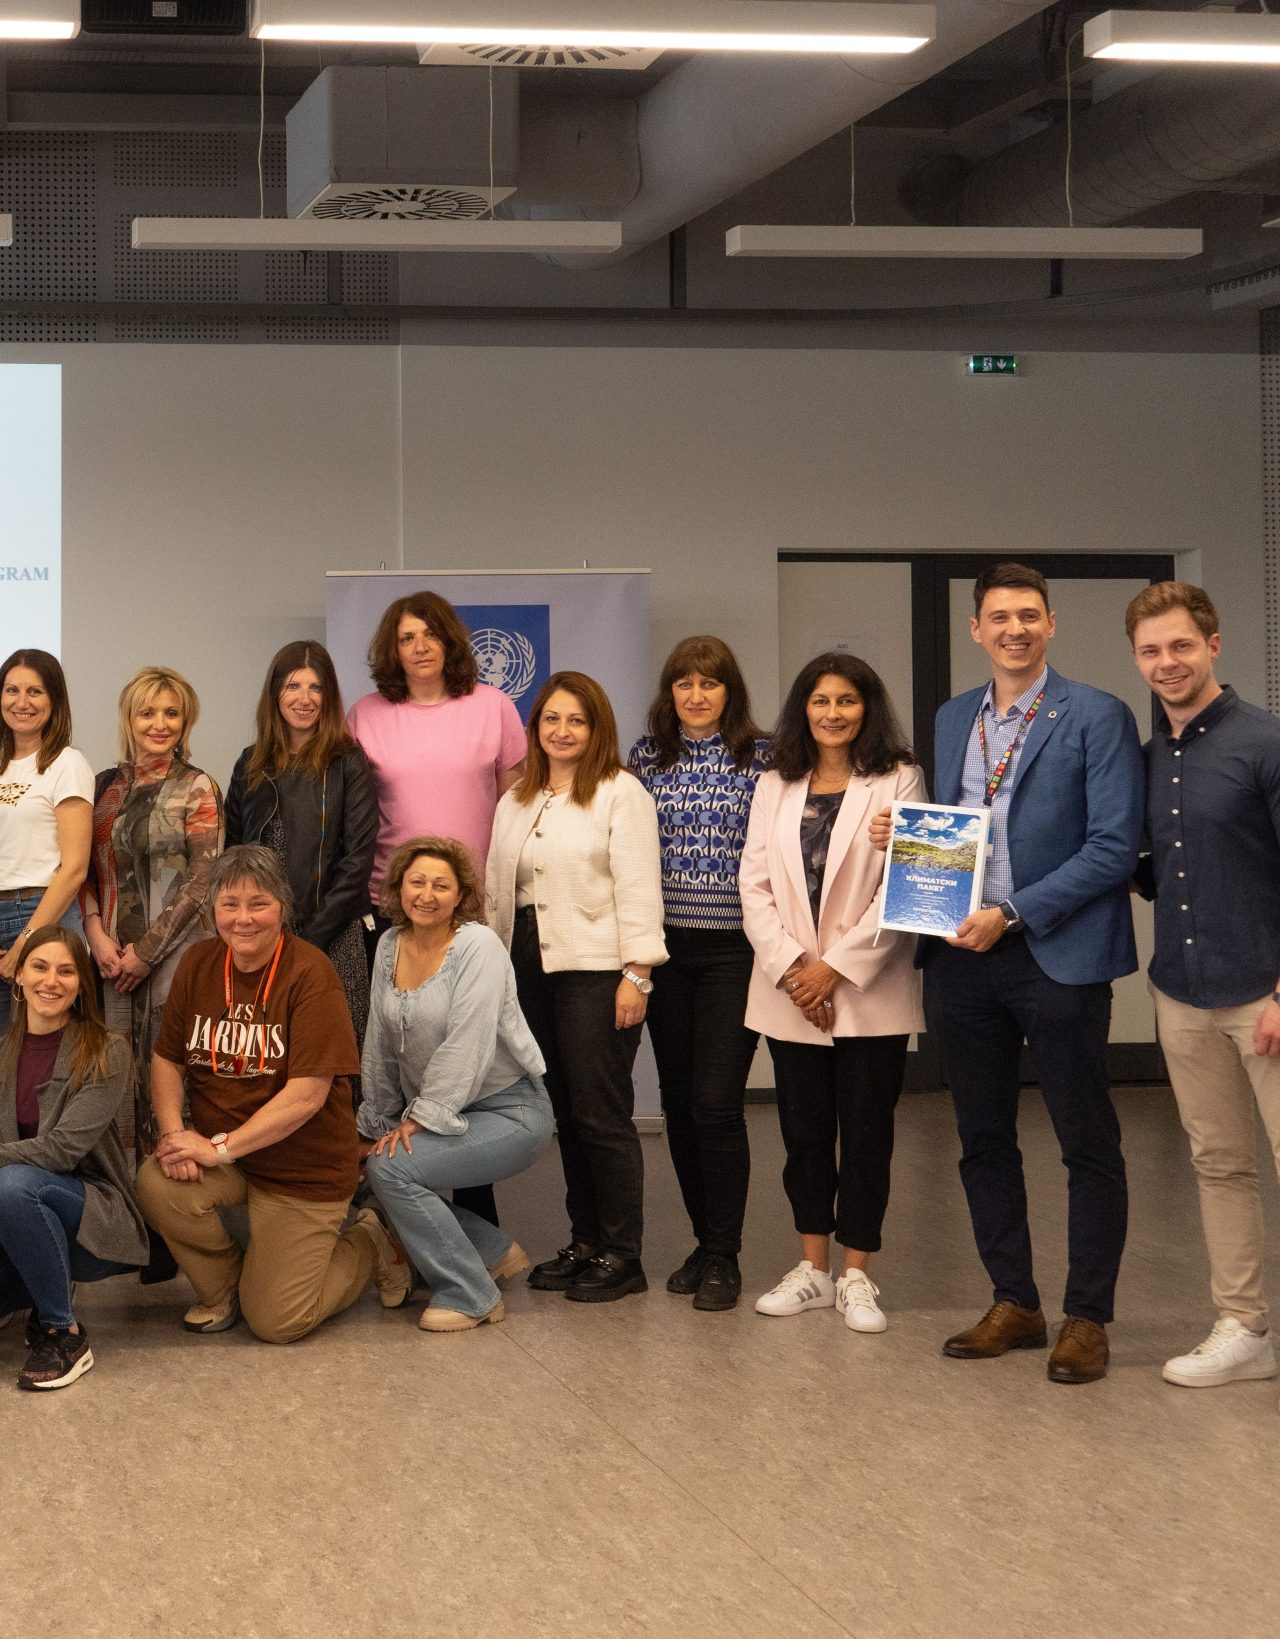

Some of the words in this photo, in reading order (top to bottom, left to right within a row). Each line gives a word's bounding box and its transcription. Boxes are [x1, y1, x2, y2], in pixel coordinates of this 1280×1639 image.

[906, 875, 957, 886] КЛИМАТСКИ
[916, 883, 945, 892] ПАКЕТ
[227, 1003, 254, 1021] LES
[185, 1014, 285, 1059] JARDINS
[188, 1053, 216, 1066] Jardi
